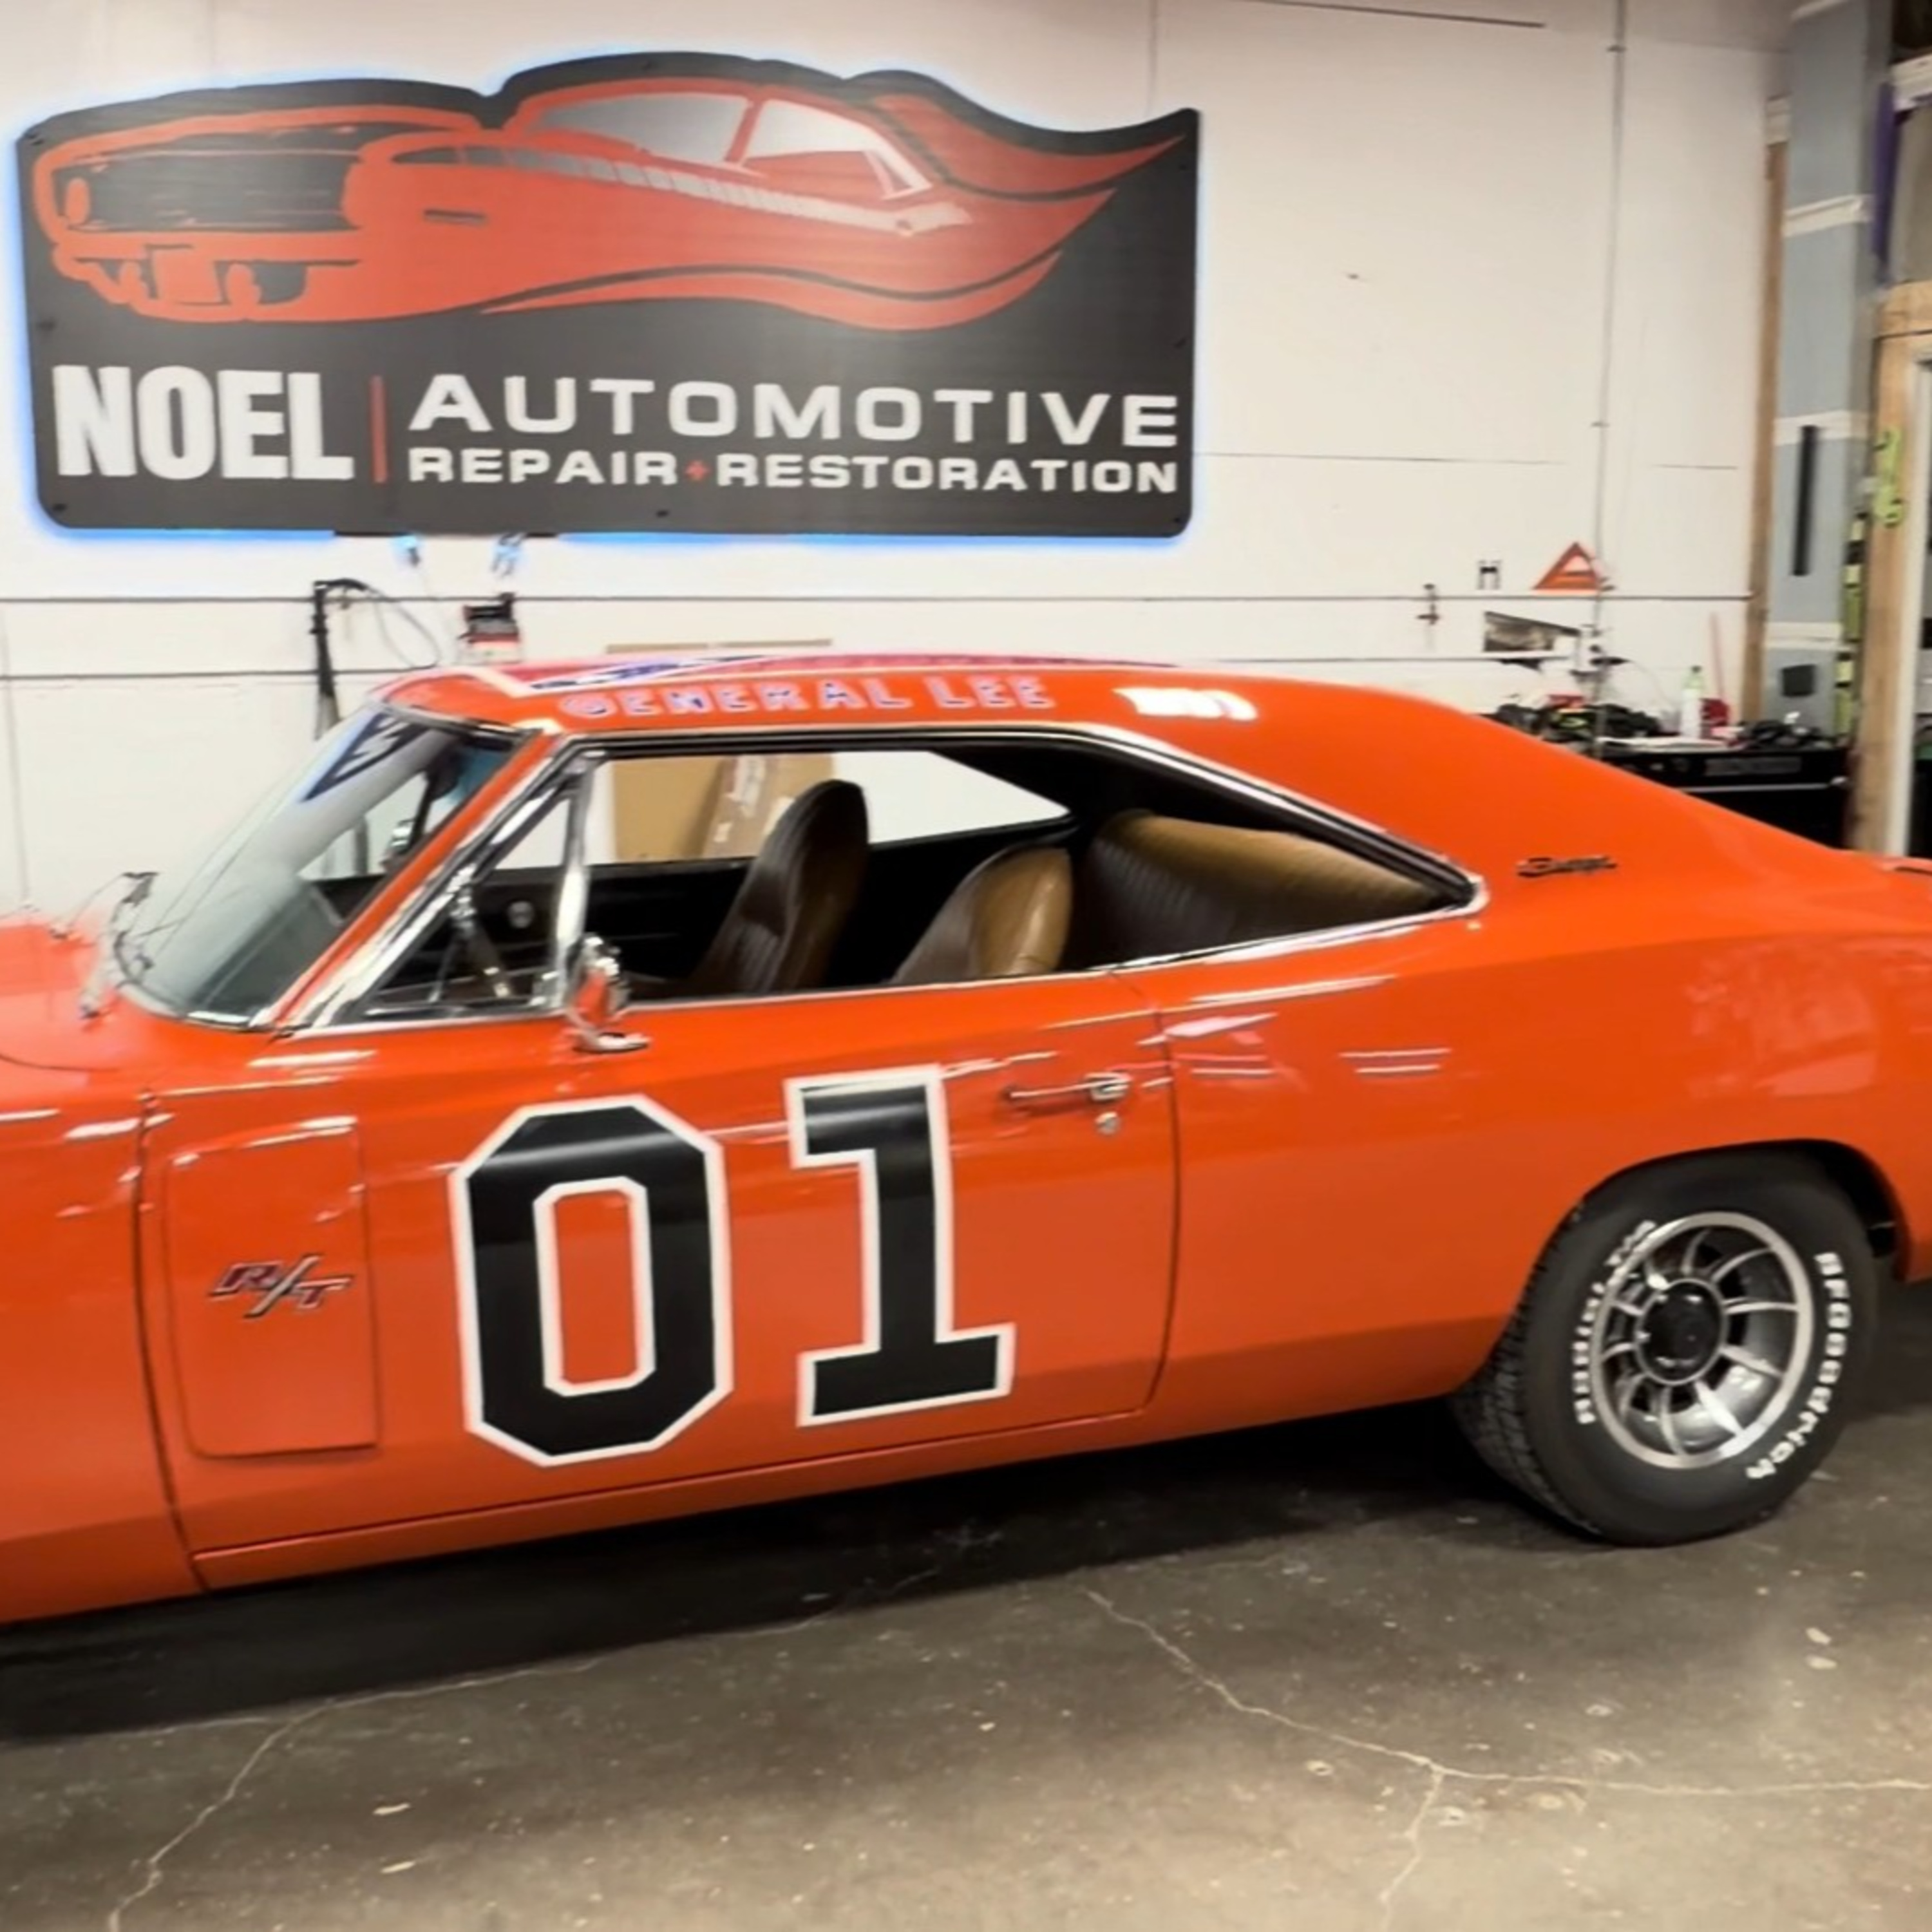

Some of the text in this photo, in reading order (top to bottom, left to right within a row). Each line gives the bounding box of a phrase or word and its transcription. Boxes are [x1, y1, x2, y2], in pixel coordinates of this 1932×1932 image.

[53, 365, 354, 480] NOEL
[408, 374, 1179, 448] AUTOMOTIVE
[408, 446, 1178, 493] REPAIR RESTORATION
[558, 674, 1056, 717] GENERAL LEE
[207, 1253, 355, 1319] R/T
[448, 1064, 1016, 1467] 01
